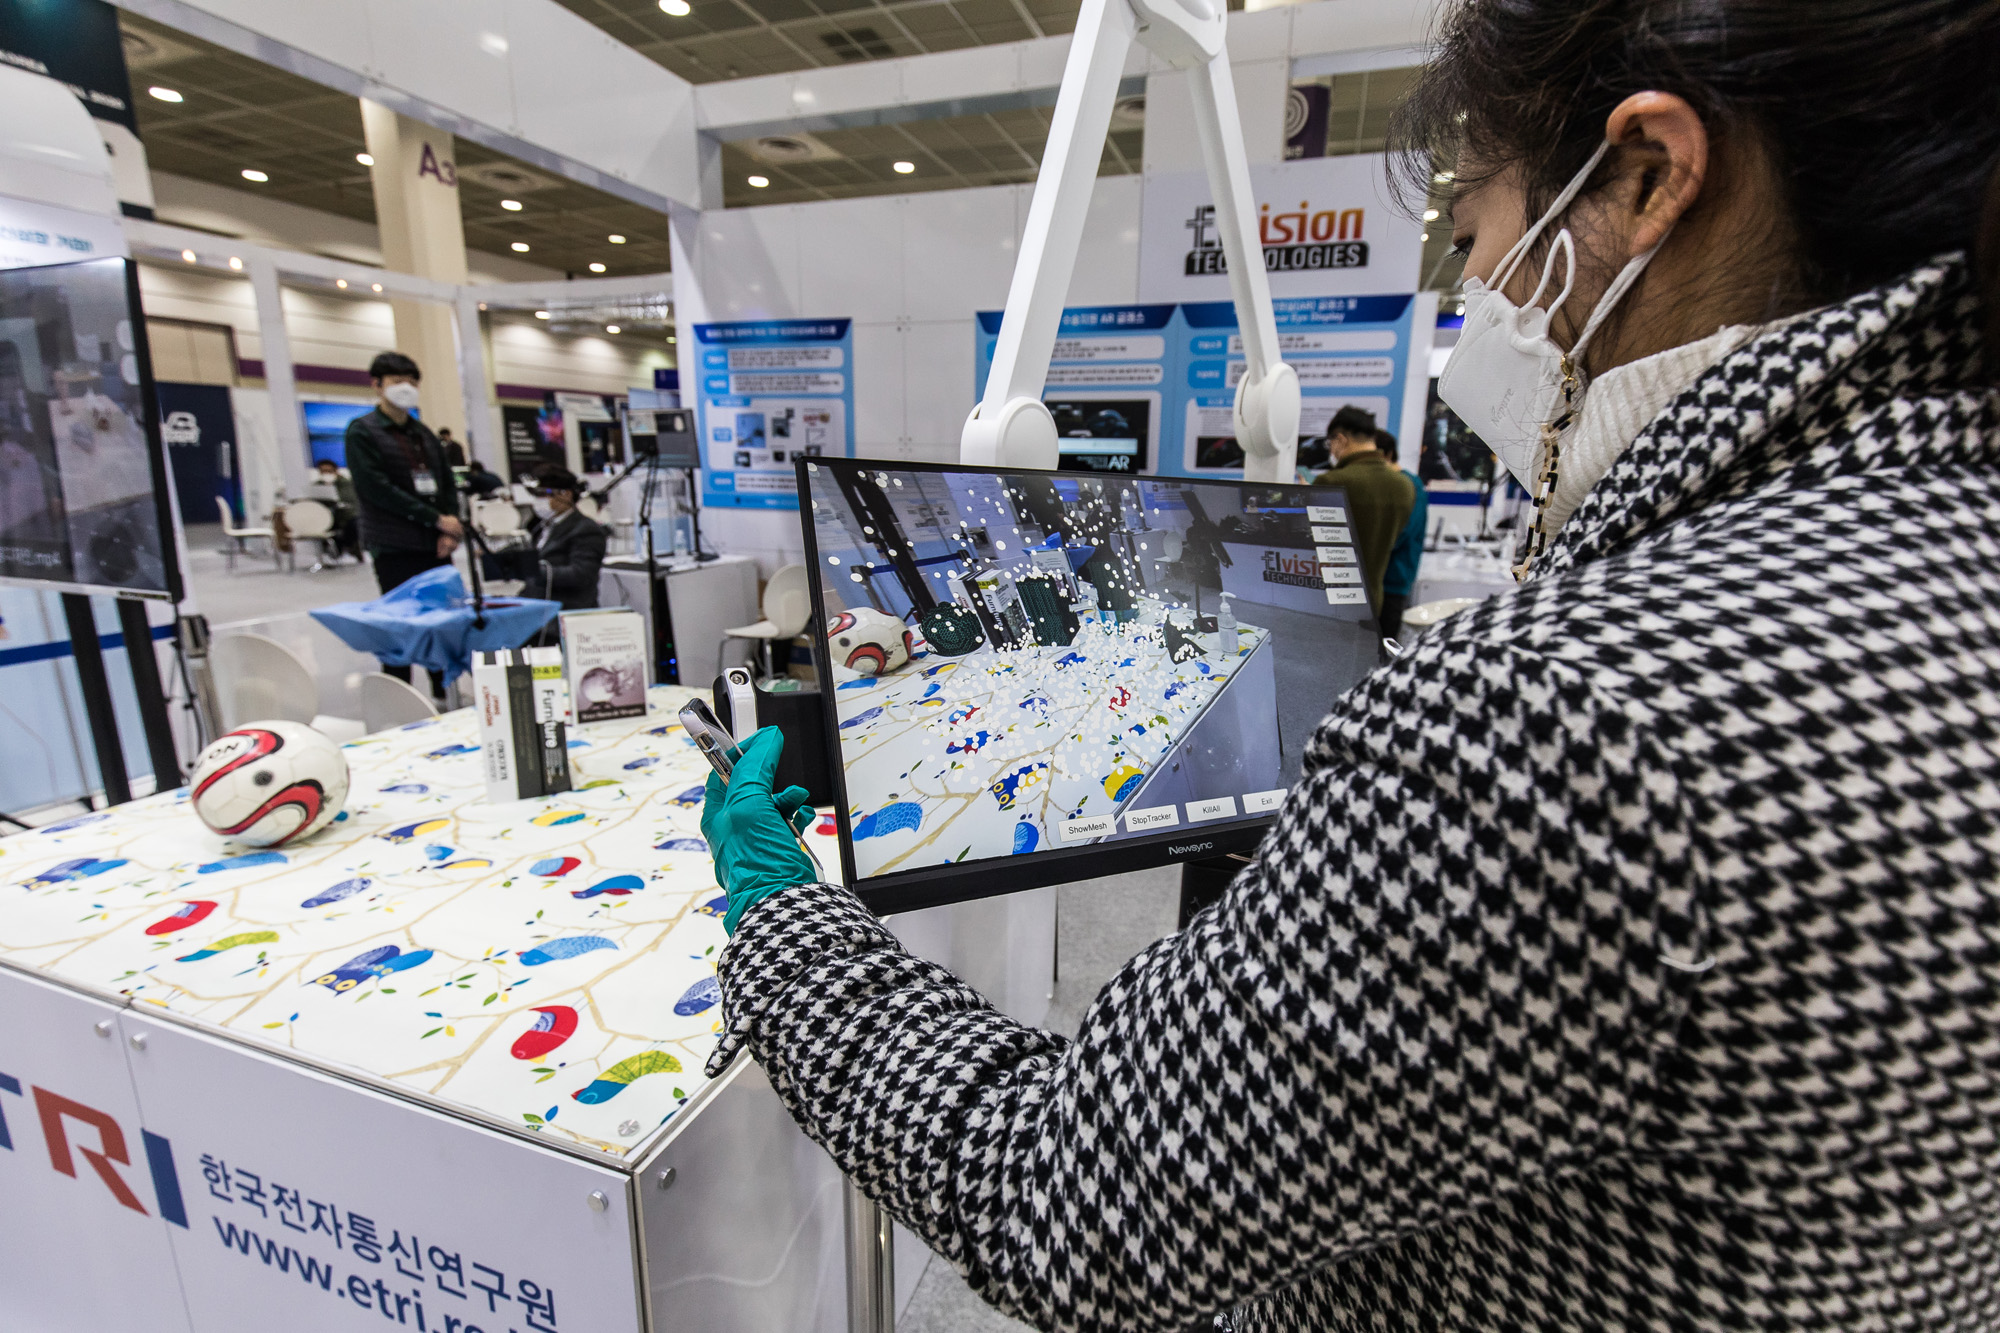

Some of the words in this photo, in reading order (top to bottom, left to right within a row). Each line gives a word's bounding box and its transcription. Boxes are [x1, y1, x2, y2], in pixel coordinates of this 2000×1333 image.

[418, 142, 457, 187] A3
[1190, 244, 1361, 274] TECOLOGIES
[1109, 455, 1130, 471] AR
[543, 689, 558, 748] Furniture
[1261, 797, 1273, 806] Exit
[1202, 805, 1221, 814] KillAll
[1132, 812, 1171, 825] StopTracker
[1068, 822, 1108, 835] ShowMesh
[1168, 841, 1214, 856] Newsync
[200, 1153, 559, 1333] 한국전자통신연구원
